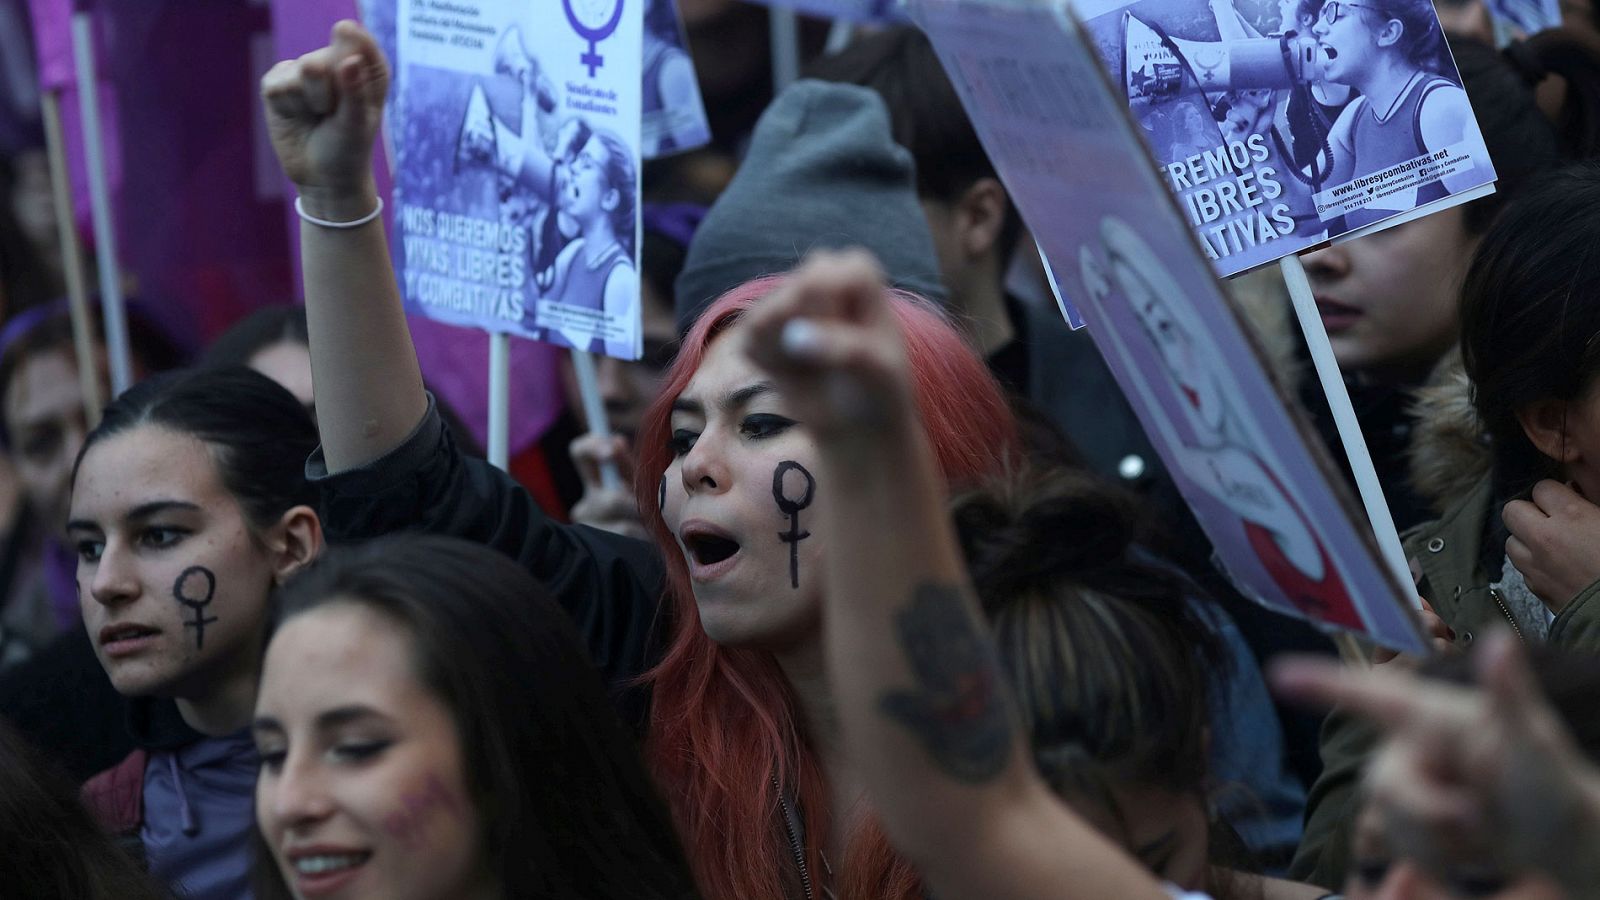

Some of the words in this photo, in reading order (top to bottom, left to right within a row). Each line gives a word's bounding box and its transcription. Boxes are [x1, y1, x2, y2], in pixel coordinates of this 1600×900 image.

[1160, 133, 1269, 192] REMOS
[1332, 148, 1449, 197] www.libresycombativas.net
[1444, 153, 1470, 168] Combativas
[1185, 166, 1282, 226] IBRES
[404, 205, 435, 237] NOS
[437, 211, 526, 253] QUEREMOS
[1199, 203, 1295, 261] ATIVAS
[458, 245, 525, 289] LIBRES
[403, 269, 417, 300] Y
[418, 272, 525, 321] COMBATIVAS
